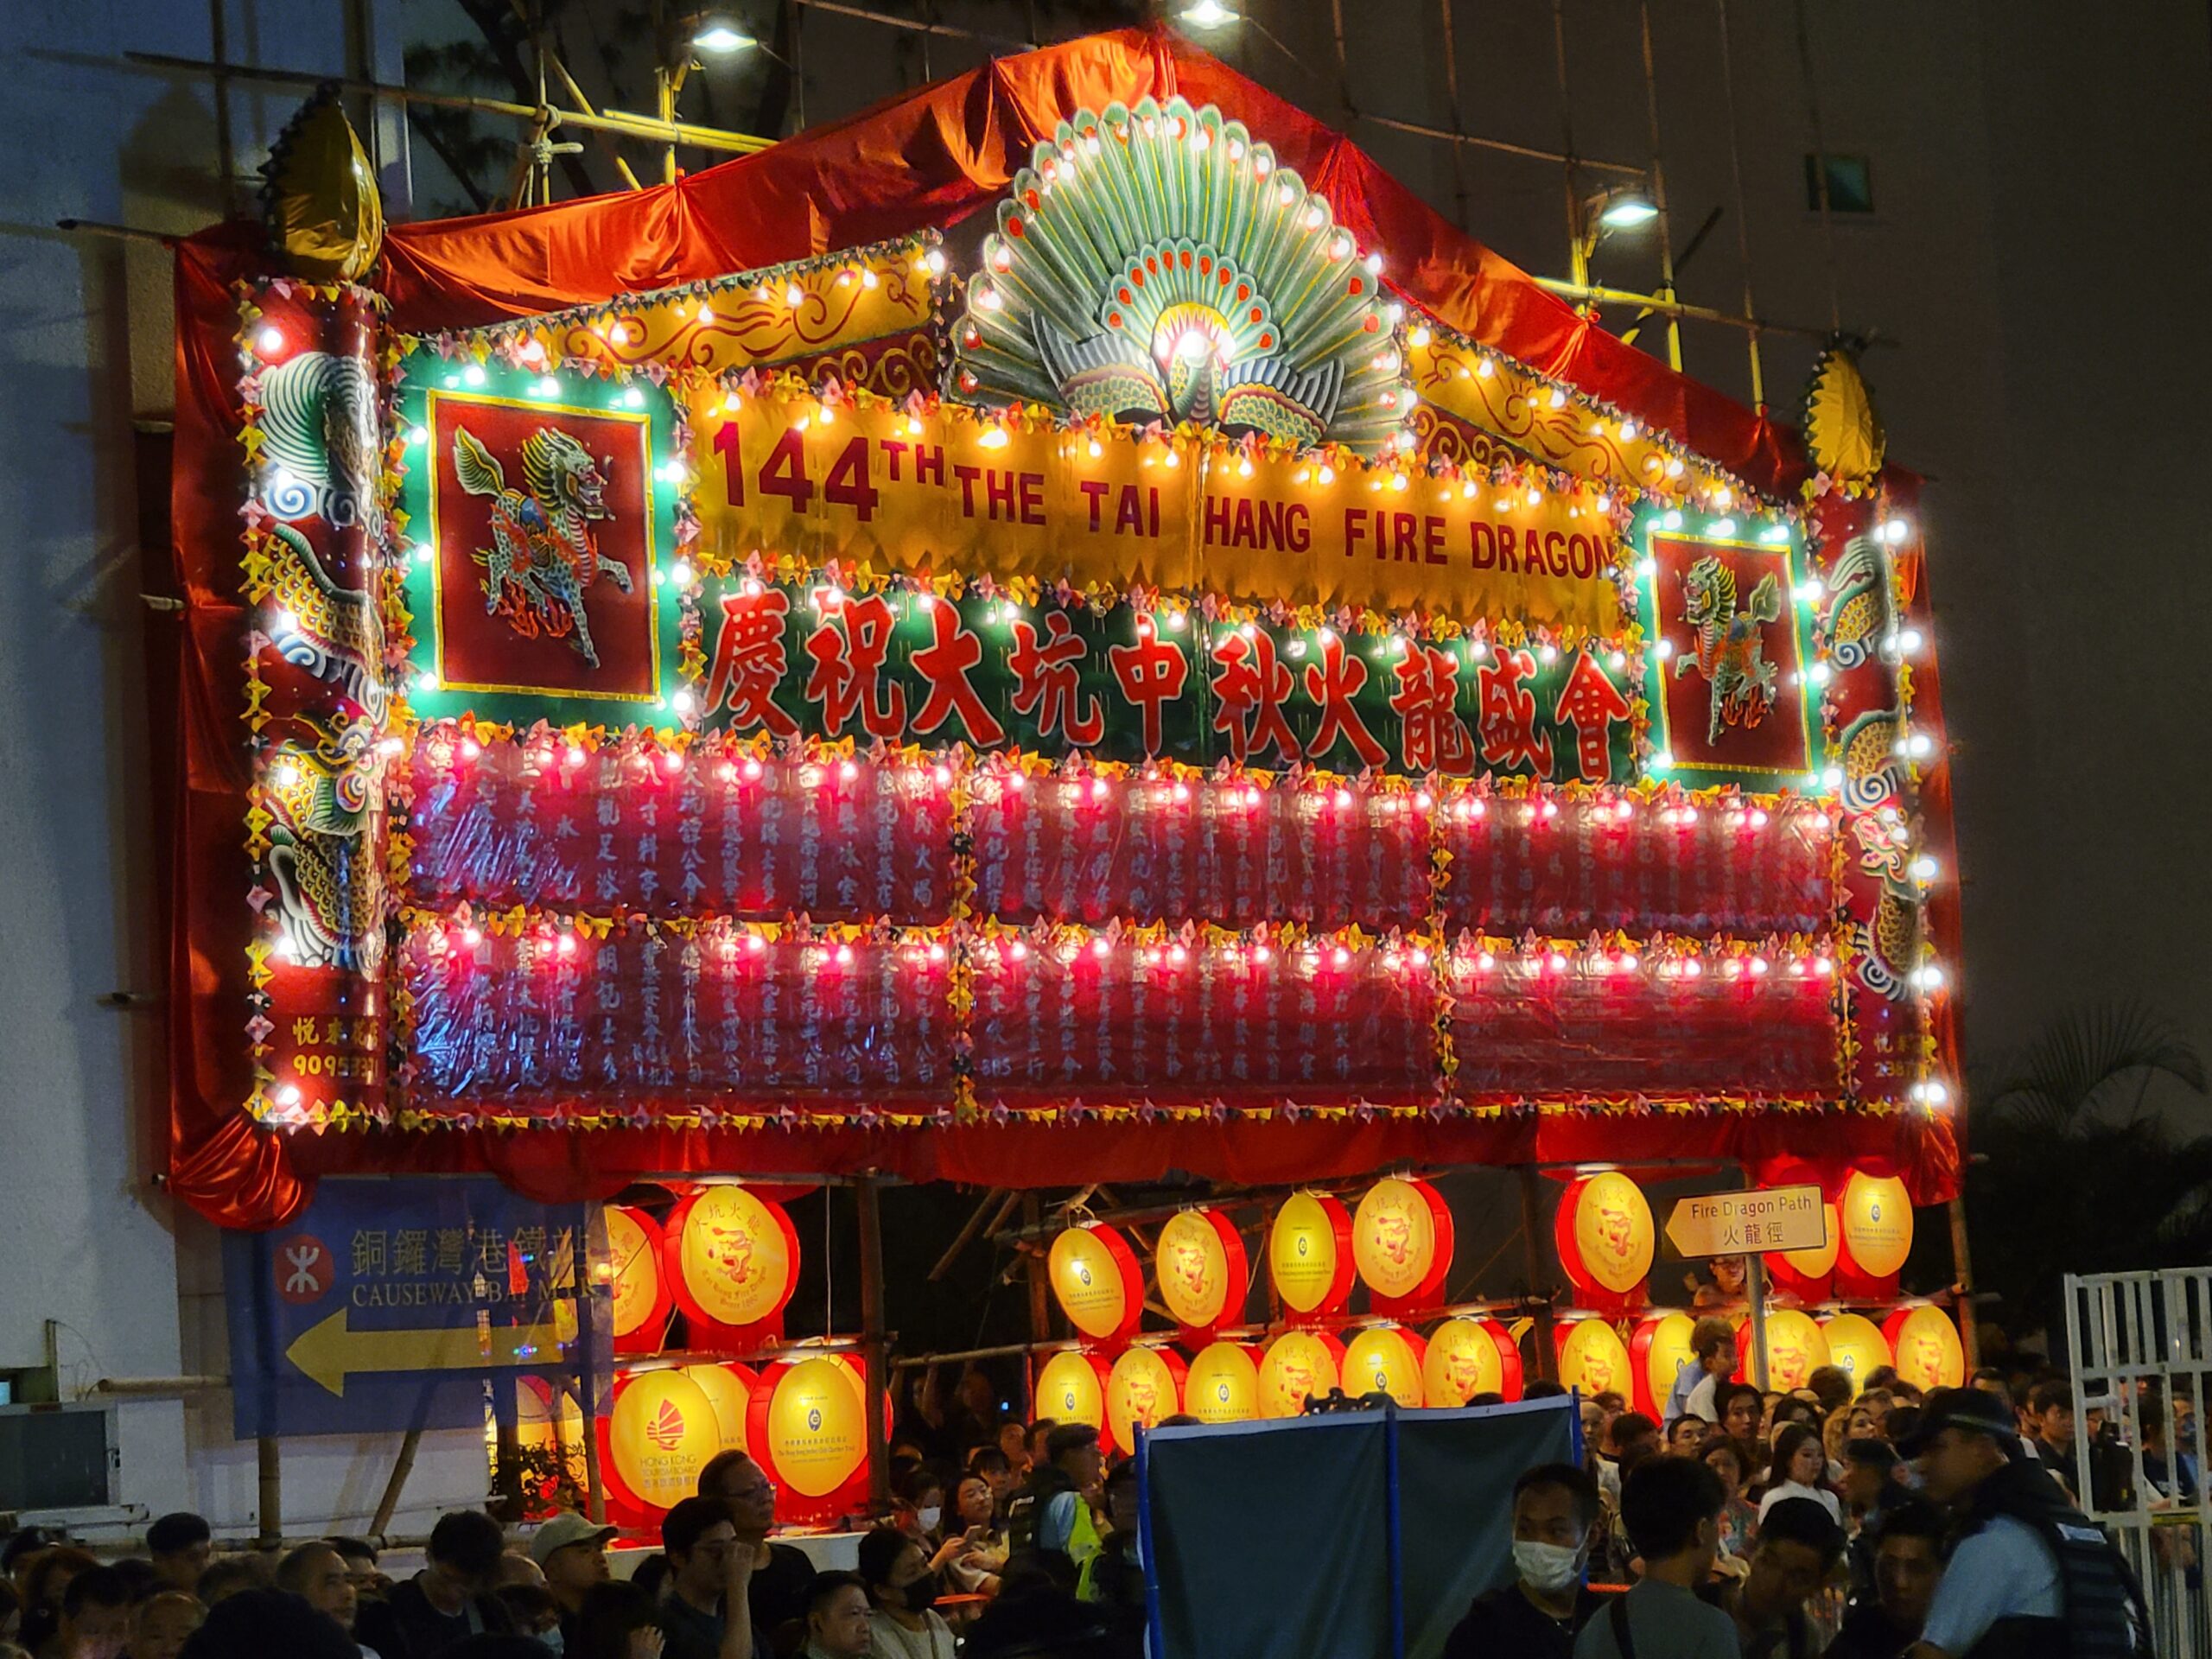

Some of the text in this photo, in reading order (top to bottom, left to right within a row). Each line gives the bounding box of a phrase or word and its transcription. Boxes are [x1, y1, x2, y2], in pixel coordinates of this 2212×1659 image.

[954, 465, 1046, 526] THE
[1080, 481, 1160, 538] TAI
[1206, 495, 1311, 553] HANG
[1344, 508, 1448, 565] FIRE
[1470, 521, 1614, 580] DRAGON
[703, 577, 1632, 782] 慶祝大坑中秋火龍盛會
[1692, 1195, 1812, 1219] Fire Dragon Path
[1724, 1221, 1784, 1246] 火龍徑
[353, 1282, 477, 1307] CAUSEWAY
[640, 1453, 697, 1467] HONG KONG
